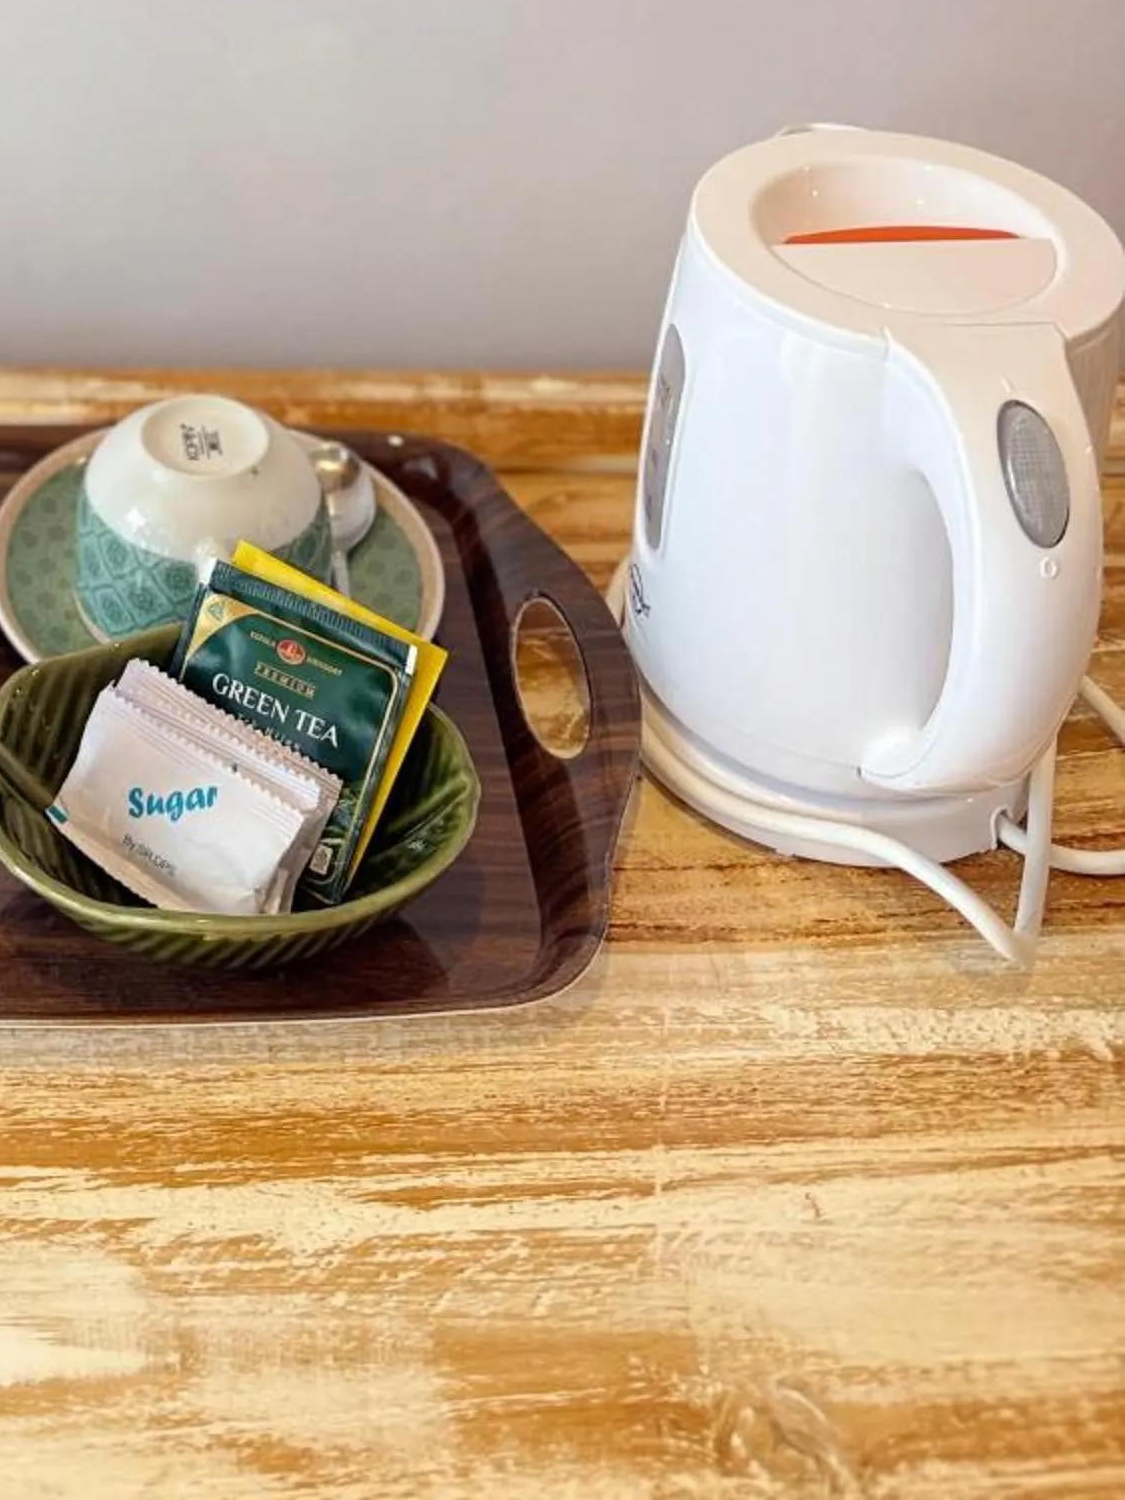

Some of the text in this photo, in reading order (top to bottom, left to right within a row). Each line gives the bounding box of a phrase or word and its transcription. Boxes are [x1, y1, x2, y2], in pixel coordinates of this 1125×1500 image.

[212, 672, 290, 724] GREEN
[295, 708, 338, 748] TEA
[128, 786, 218, 822] Sugar
